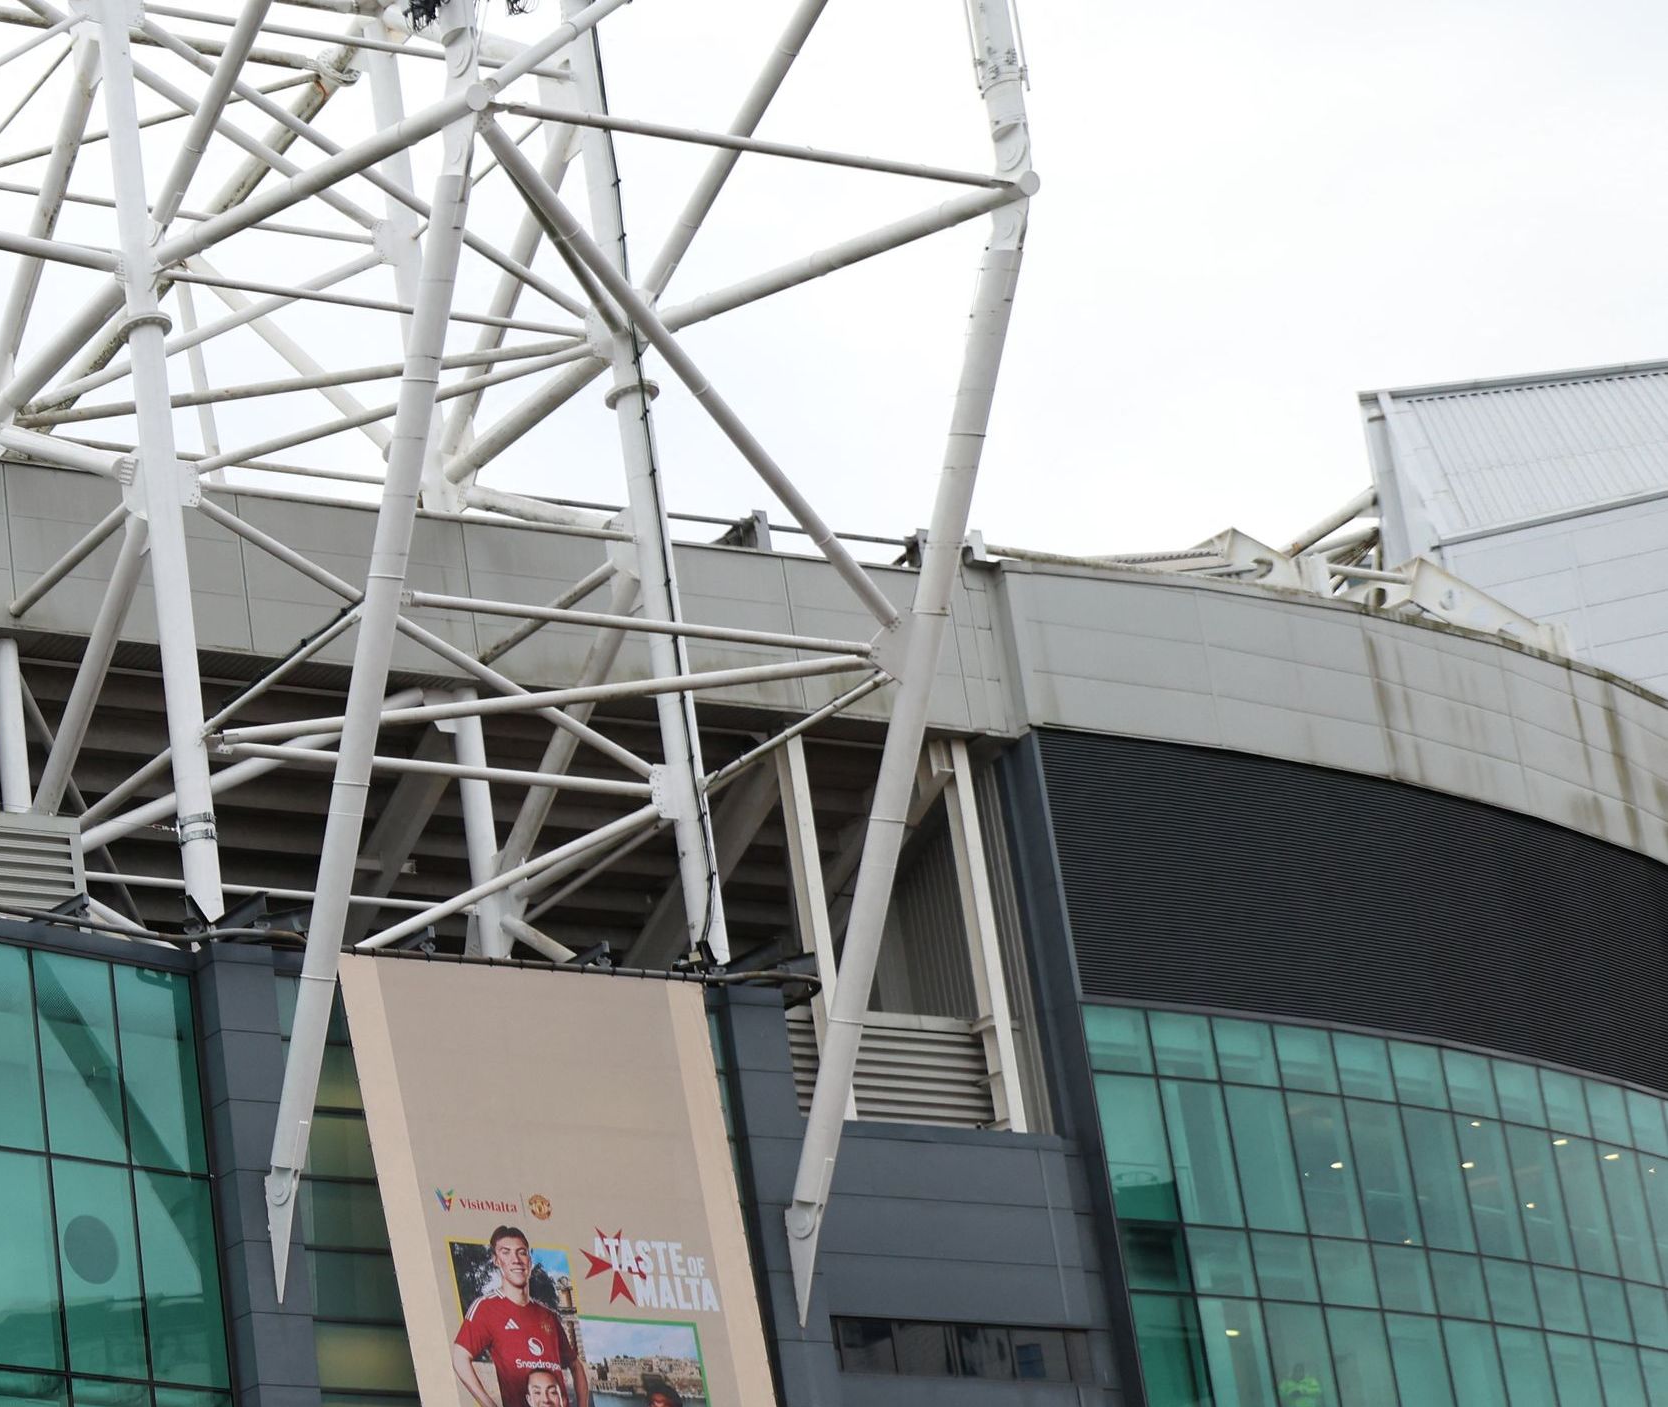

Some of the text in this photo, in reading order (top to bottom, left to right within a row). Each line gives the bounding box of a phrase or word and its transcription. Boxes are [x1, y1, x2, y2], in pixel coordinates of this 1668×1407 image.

[459, 1198, 518, 1214] VisitMalta
[603, 1237, 686, 1276] TASTE
[687, 1257, 706, 1277] OF
[633, 1275, 720, 1312] MALTA
